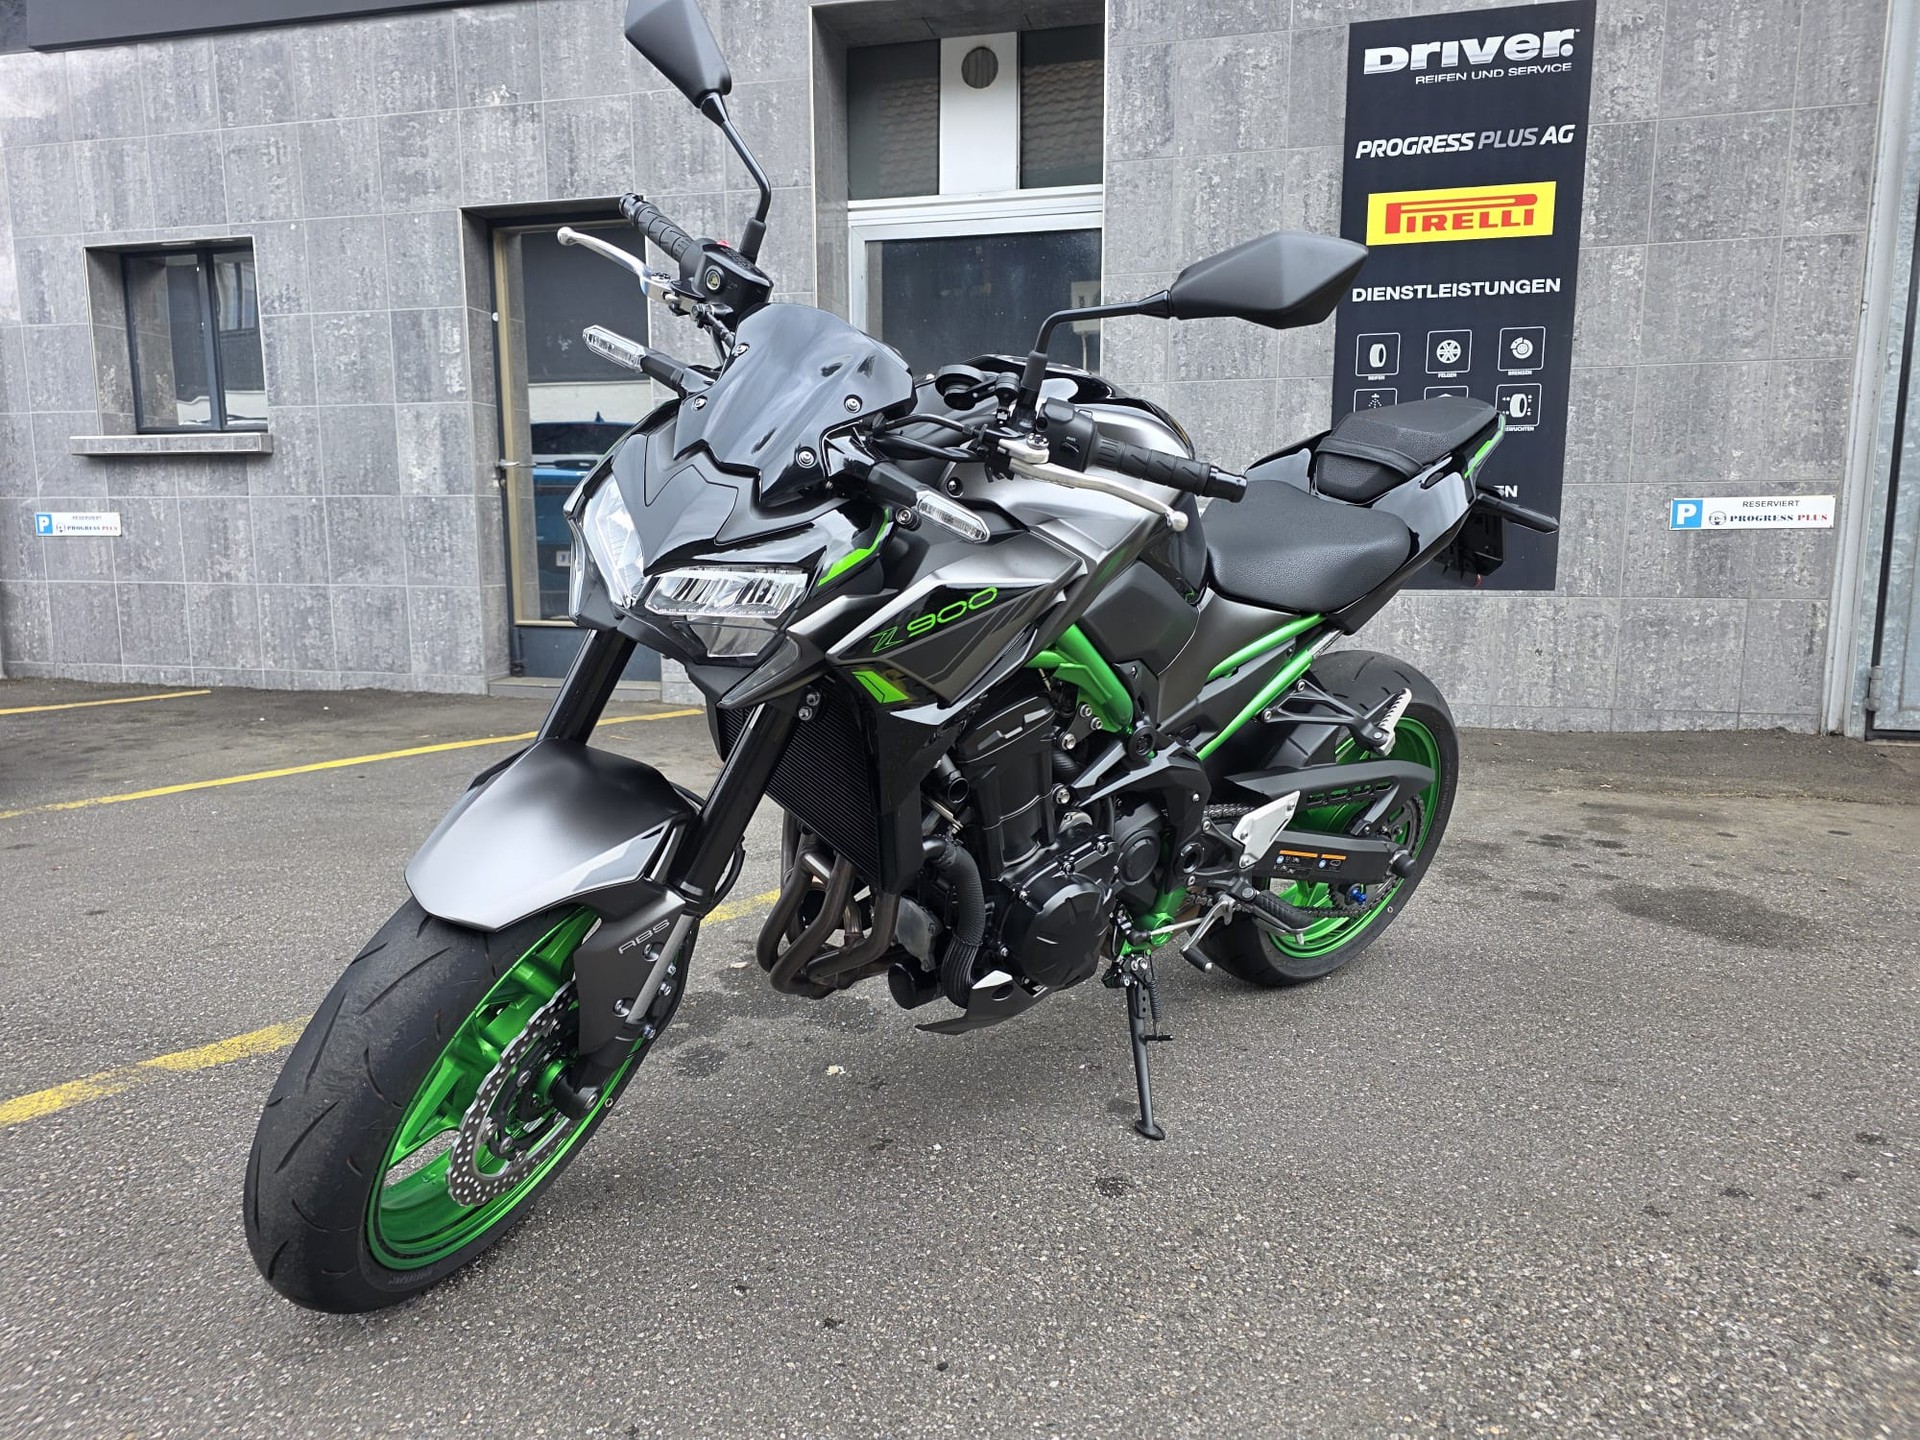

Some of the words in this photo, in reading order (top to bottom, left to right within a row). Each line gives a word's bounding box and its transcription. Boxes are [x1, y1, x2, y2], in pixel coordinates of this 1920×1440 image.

[1415, 72, 1467, 84] REIFEN
[1471, 68, 1504, 80] UND
[1508, 63, 1572, 76] SERVICE
[1355, 132, 1475, 159] PROGRESS
[1478, 127, 1539, 149] PLUS
[1540, 124, 1576, 145] AG
[1385, 193, 1538, 234] PIRELLI
[1352, 278, 1561, 302] DIENSTLEISTUNGEN
[1676, 503, 1697, 525] P
[1742, 499, 1800, 507] RESERVIERT
[38, 515, 50, 532] P
[1729, 514, 1794, 522] PROGRESS
[1797, 513, 1828, 521] PLUS
[618, 919, 670, 954] ABS
